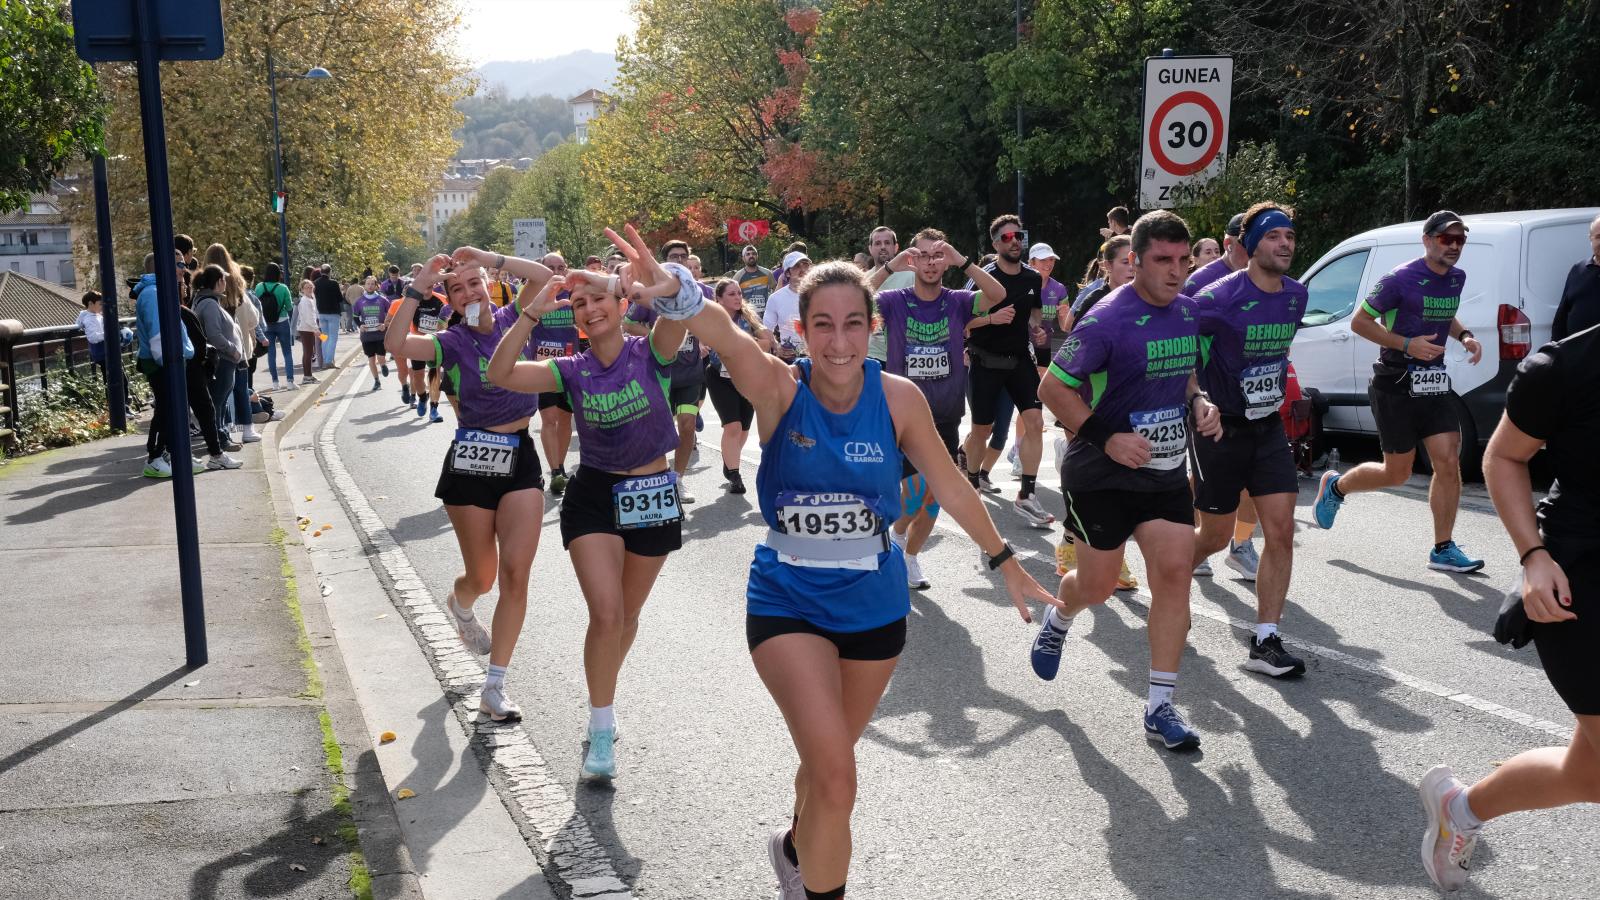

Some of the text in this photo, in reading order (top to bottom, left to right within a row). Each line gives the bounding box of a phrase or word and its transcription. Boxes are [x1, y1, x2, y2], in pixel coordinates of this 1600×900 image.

[1158, 67, 1221, 84] GUNEA
[1167, 120, 1208, 149] 30
[909, 355, 948, 369] 23018
[1413, 372, 1447, 385] 24497
[1140, 422, 1185, 444] 24233
[456, 445, 512, 464] 23277
[469, 463, 495, 471] BEATRIZ
[620, 488, 675, 514] 9315
[640, 512, 663, 521] LAURA
[787, 508, 874, 535] 19533
